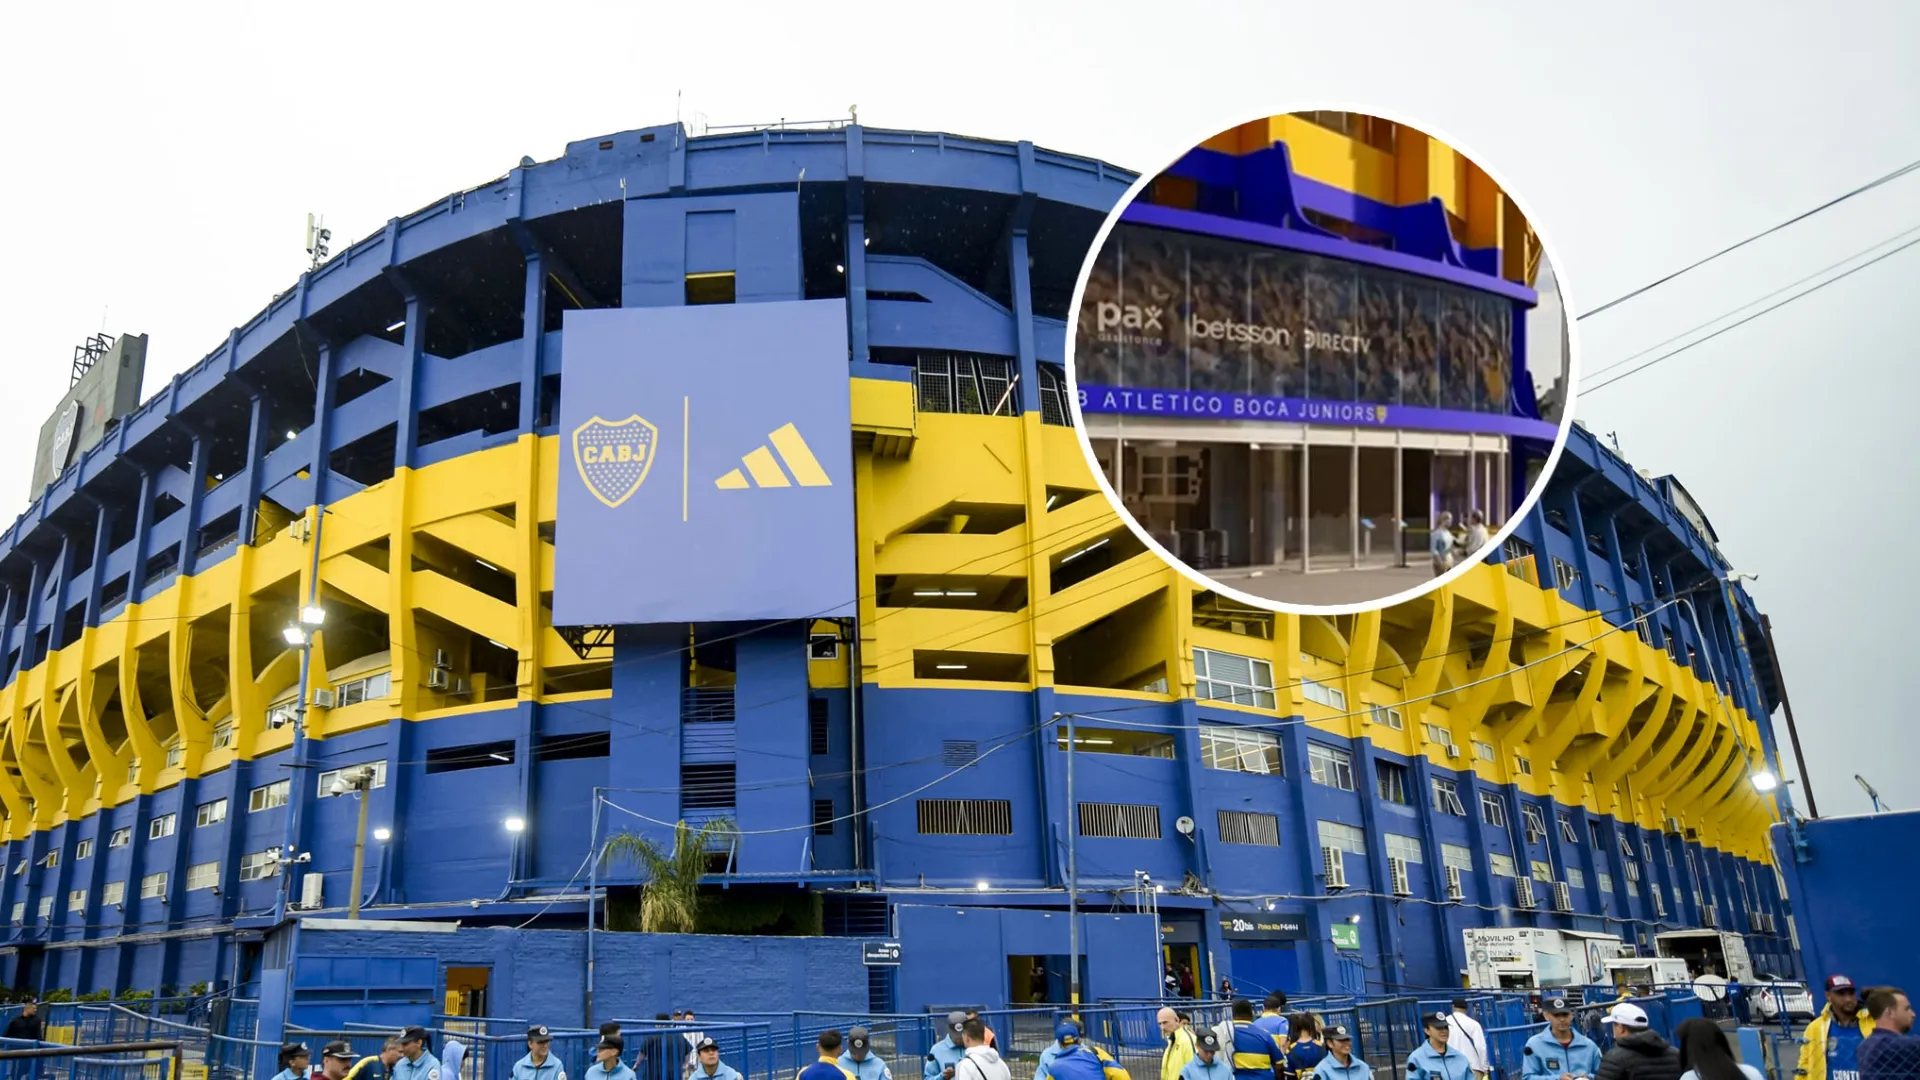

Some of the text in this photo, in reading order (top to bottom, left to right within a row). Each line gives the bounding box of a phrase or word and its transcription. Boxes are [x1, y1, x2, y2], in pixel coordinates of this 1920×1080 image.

[1097, 301, 1163, 332] pax
[1193, 313, 1290, 346] betsson
[1303, 328, 1371, 354] DIRECTV
[1103, 391, 1222, 414] ATLETICO
[1233, 398, 1289, 416] BOCA
[1298, 403, 1375, 422] JUNIORS
[583, 443, 646, 463] CABJ
